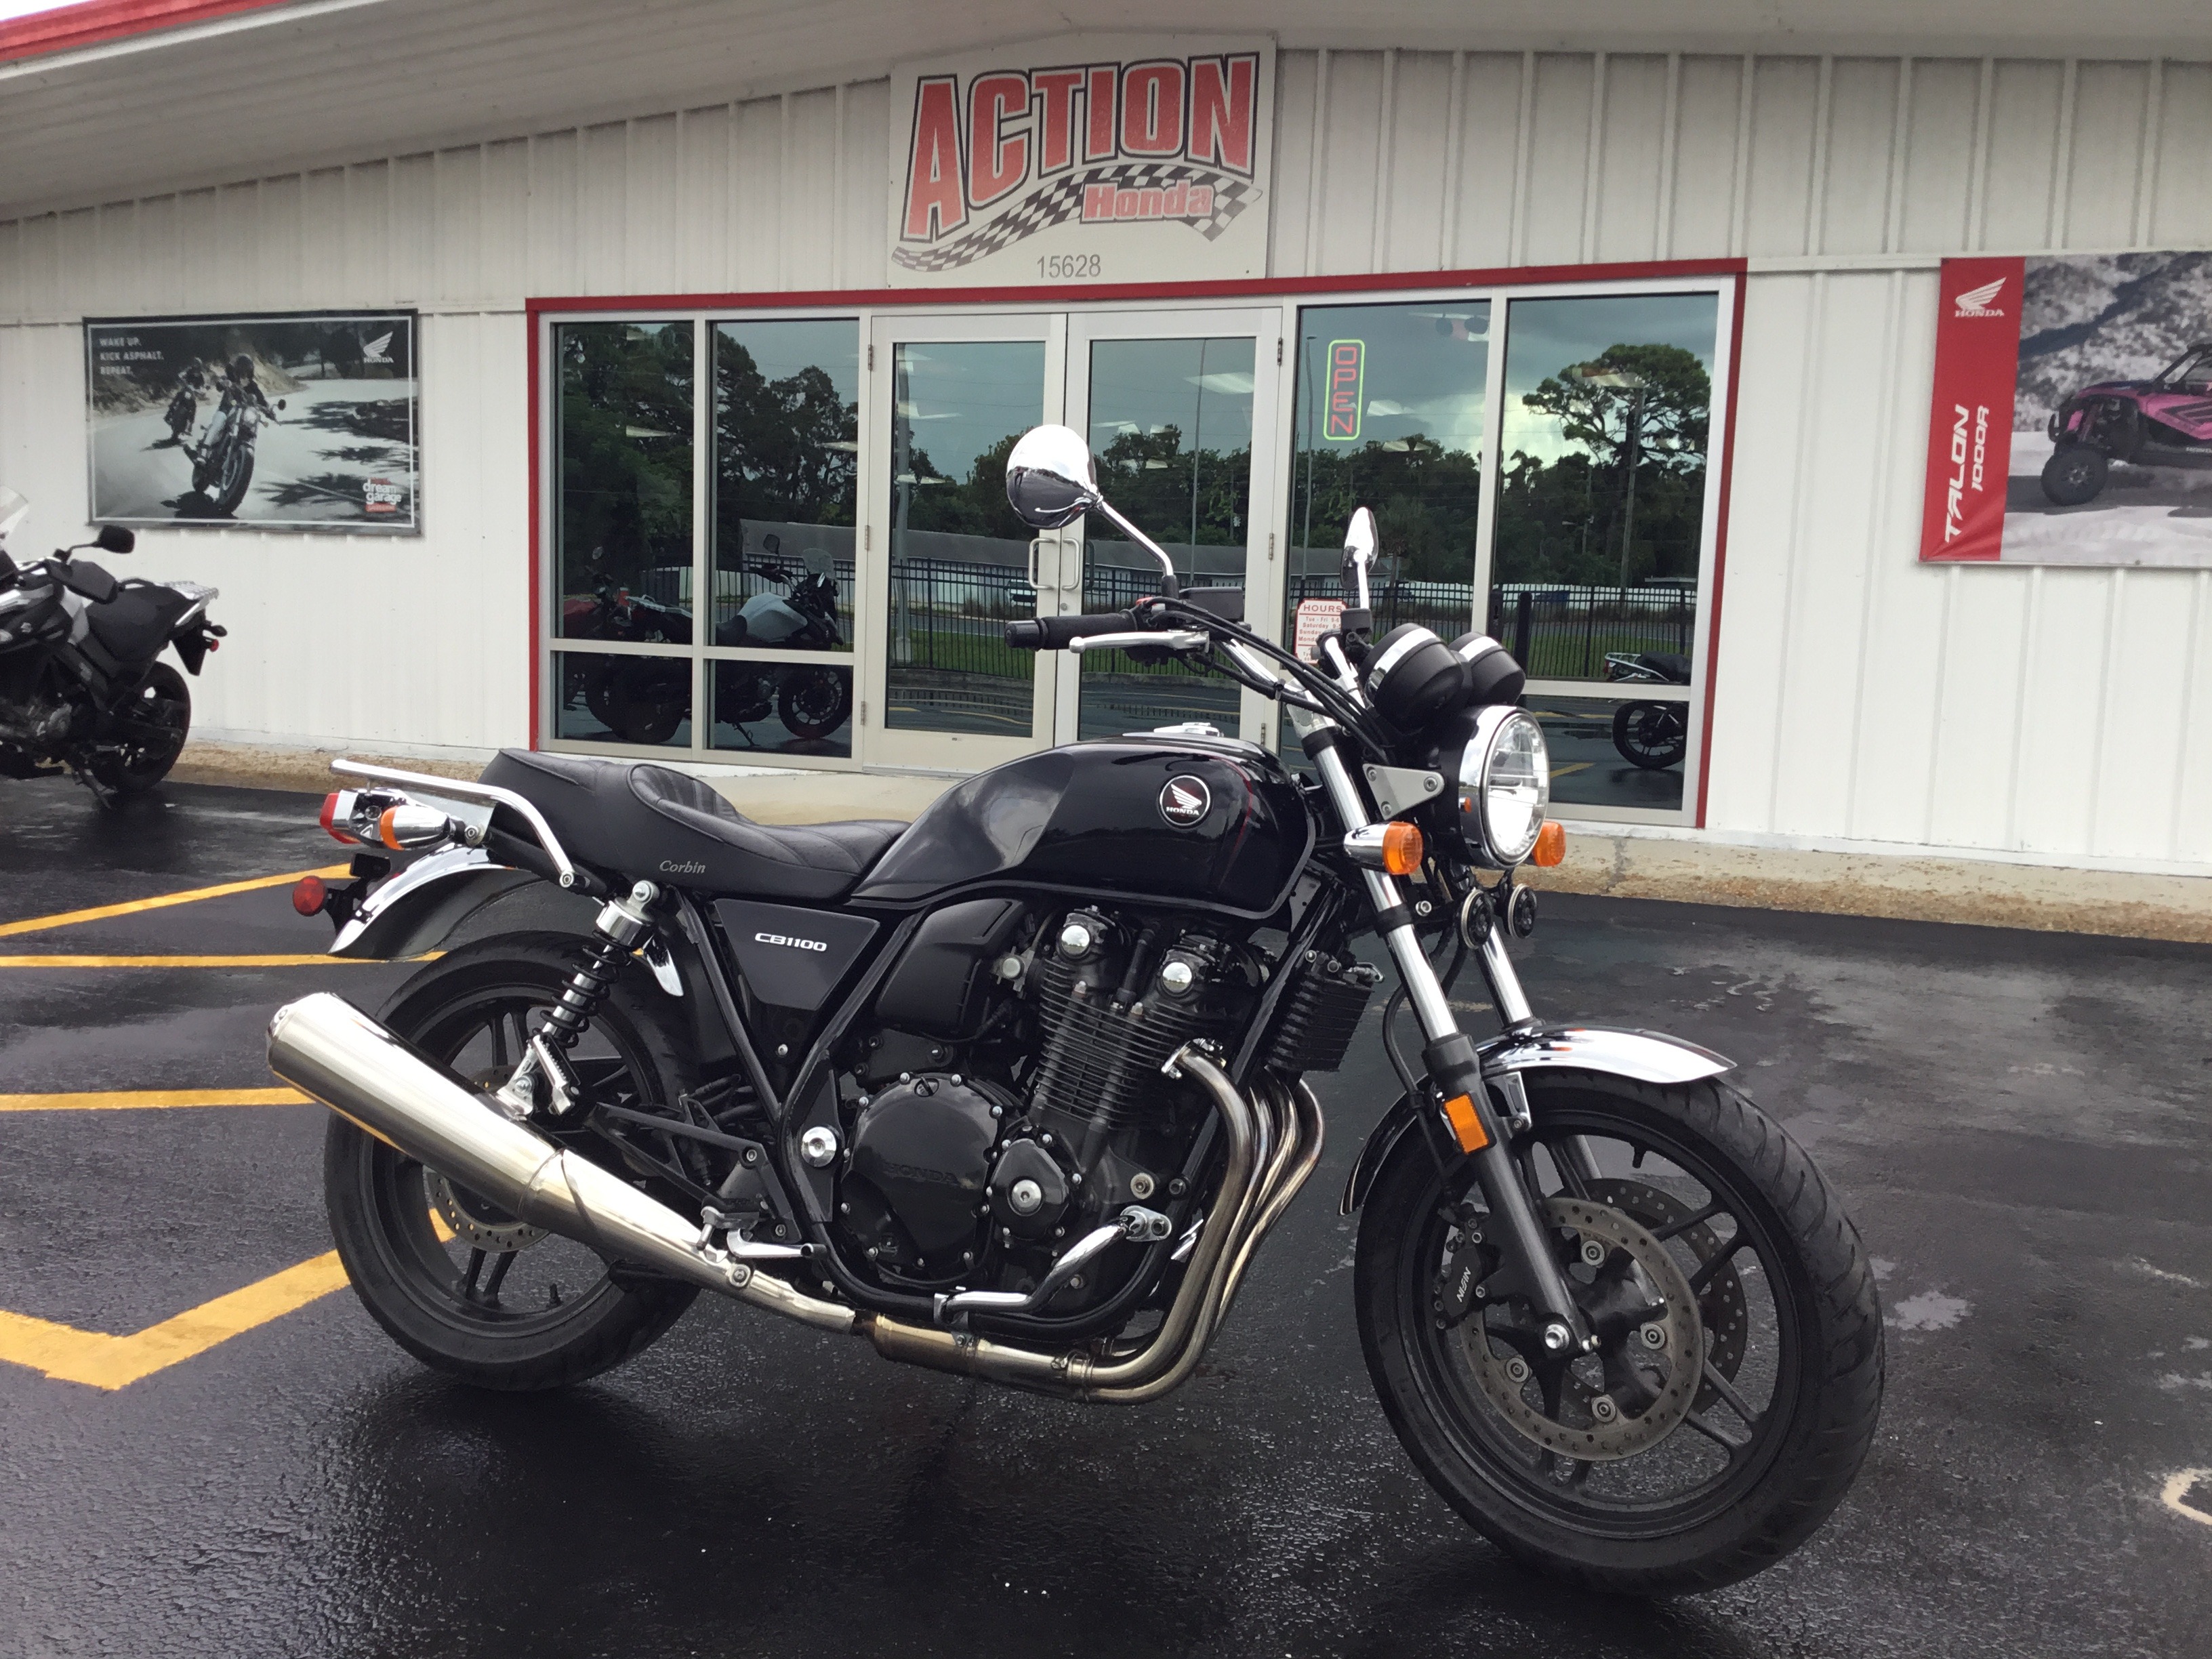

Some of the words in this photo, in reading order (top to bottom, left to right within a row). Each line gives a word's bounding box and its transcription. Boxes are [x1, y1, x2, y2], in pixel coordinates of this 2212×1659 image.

[900, 52, 1260, 243] ACTION
[1081, 178, 1215, 224] Honda
[1036, 254, 1102, 279] 15628
[1954, 308, 2005, 317] HONDA
[100, 352, 121, 361] KICK
[123, 350, 165, 361] ASPHALT.
[1330, 346, 1358, 435] OPEN
[1971, 405, 1990, 492] 1000R
[1944, 403, 1969, 544] TALON
[362, 478, 396, 493] dream
[365, 492, 402, 505] garage
[1166, 806, 1200, 816] HONDA
[659, 859, 706, 874] Corbin
[754, 933, 827, 952] CB1100
